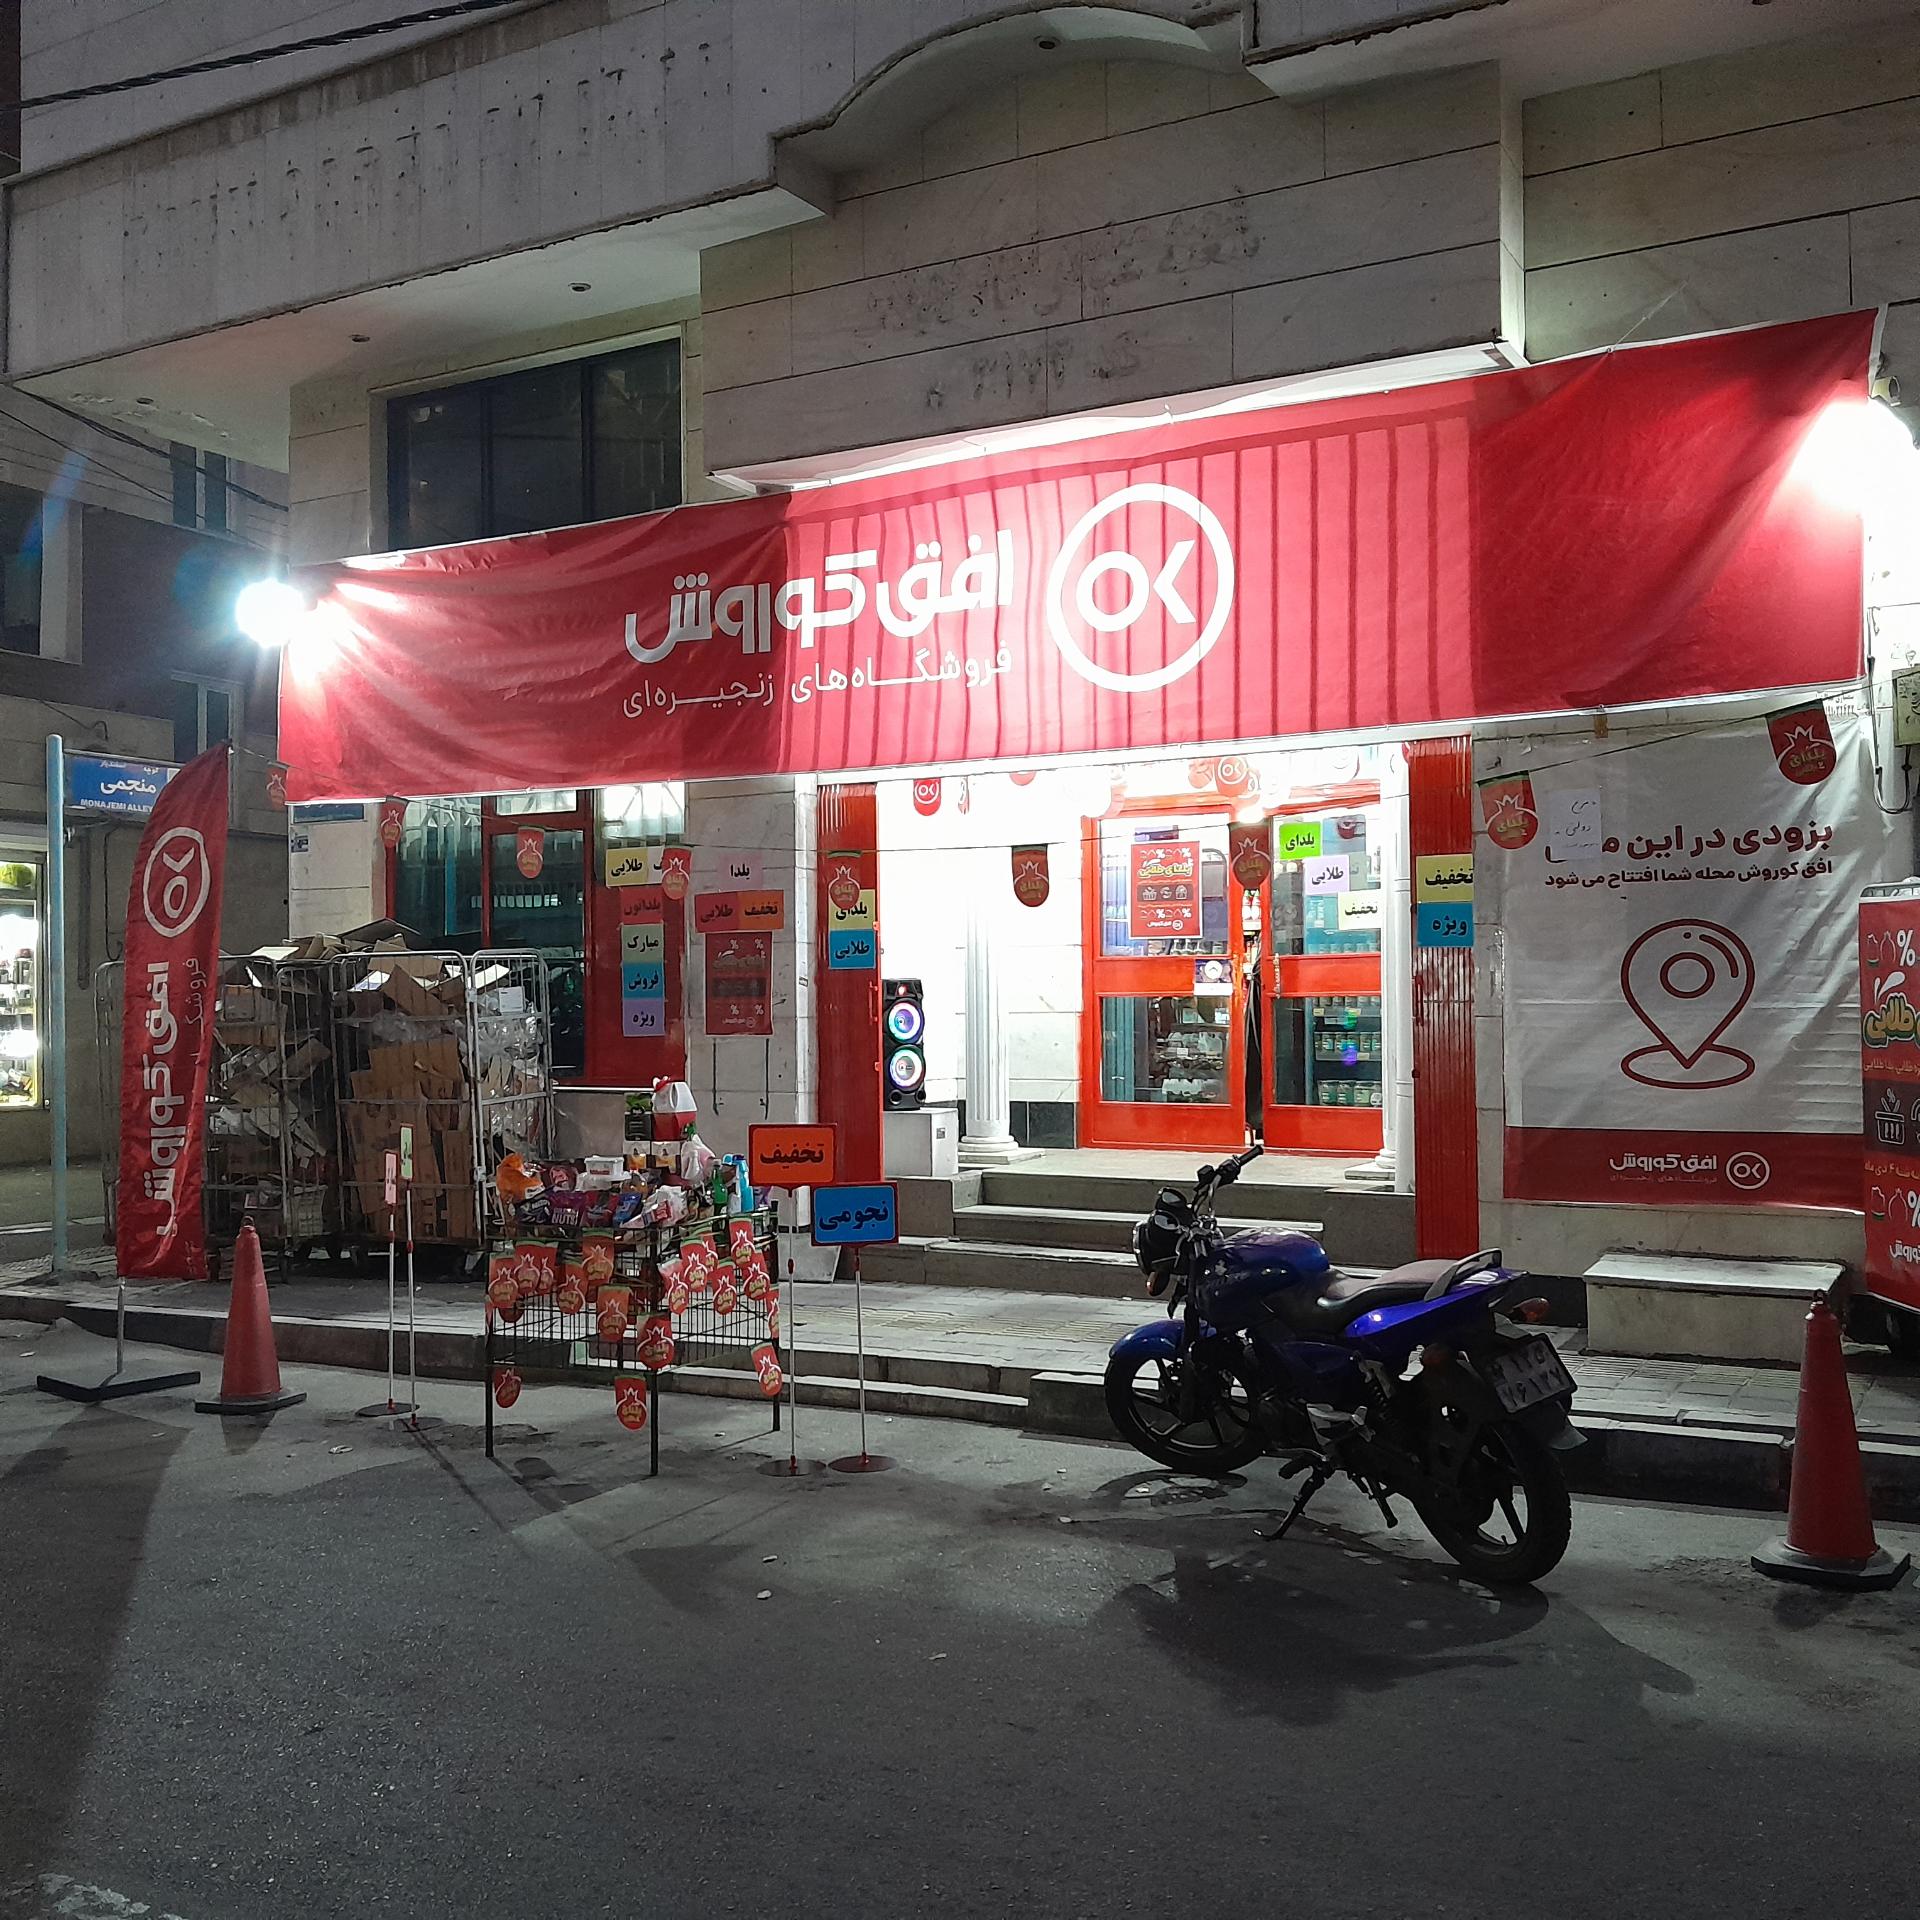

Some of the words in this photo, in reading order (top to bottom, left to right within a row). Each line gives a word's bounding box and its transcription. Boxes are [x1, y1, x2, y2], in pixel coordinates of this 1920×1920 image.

[876, 529, 1014, 638] افق
[625, 549, 878, 664] کوروش
[100, 778, 157, 796] منجمی
[80, 798, 126, 810] MONAJEMI
[127, 803, 153, 813] ALLEY
[1285, 832, 1315, 851] یلدای
[1627, 825, 1684, 860] این
[1690, 828, 1726, 857] در
[1733, 820, 1833, 856] بزودی
[610, 859, 643, 877] طلایی
[730, 864, 750, 879] یلدا
[1311, 865, 1344, 885] طلایی
[1608, 866, 1658, 889] افتتاح
[1661, 866, 1692, 881] شما
[1695, 867, 1736, 880] محله
[1738, 862, 1799, 883] کوروش
[1801, 858, 1832, 879] افق
[1425, 869, 1473, 889] تخفیف
[1545, 872, 1579, 889] شود
[1582, 875, 1605, 888] می
[701, 905, 733, 922] طلایی
[744, 901, 778, 916] تخفیف
[835, 902, 868, 920] یلدای
[1344, 902, 1378, 918] تخفیف
[1433, 915, 1467, 936] ویژه
[627, 935, 660, 953] مبارک
[835, 940, 869, 959] طلایی
[628, 970, 659, 990] فروش
[146, 961, 178, 1055] افق
[632, 1011, 656, 1028] ویژه
[143, 1053, 187, 1236] کوروش
[760, 1143, 824, 1169] تخفیف
[1609, 1153, 1681, 1172] کوروش
[1680, 1155, 1717, 1173] افق
[819, 1201, 889, 1230] نجومی
